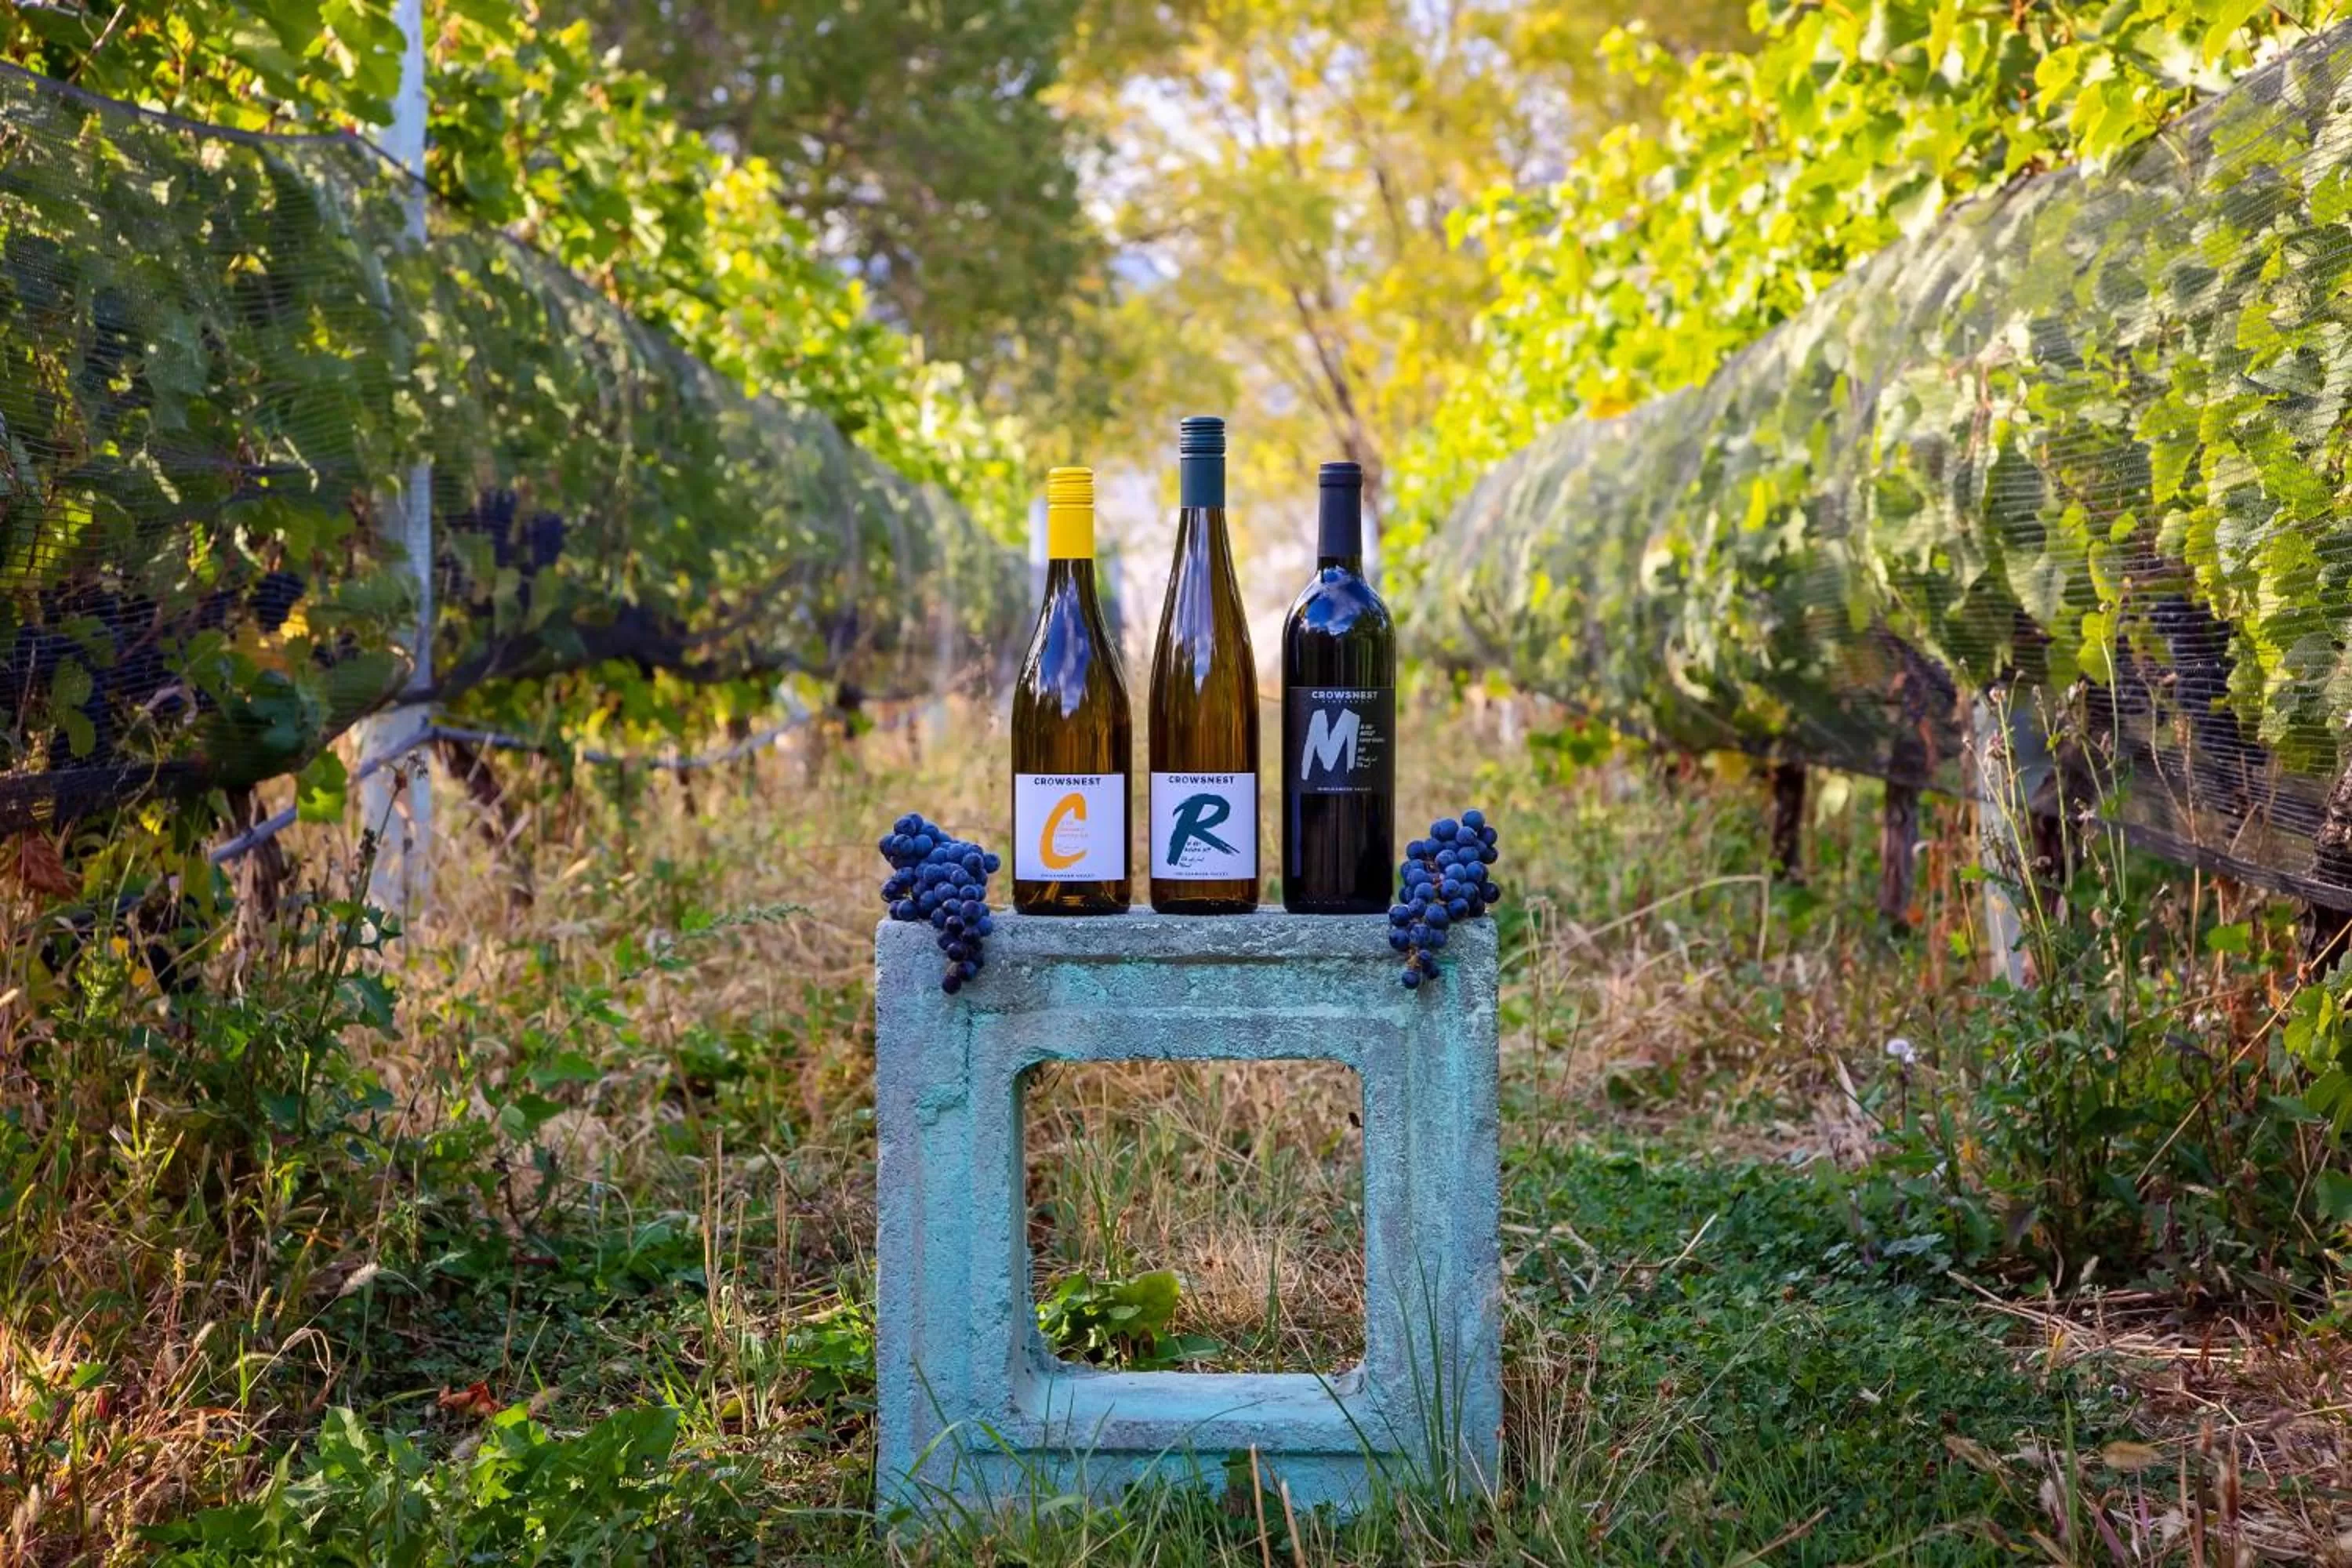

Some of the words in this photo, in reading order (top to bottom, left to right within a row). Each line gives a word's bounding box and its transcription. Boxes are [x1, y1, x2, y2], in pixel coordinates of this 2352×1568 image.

[1311, 691, 1377, 699] CROWSNEST
[1301, 708, 1360, 780] M
[1034, 777, 1101, 786] CROWSNEST
[1168, 775, 1235, 784] CROWSNEST
[1040, 793, 1087, 869] C
[1167, 793, 1241, 866] R
